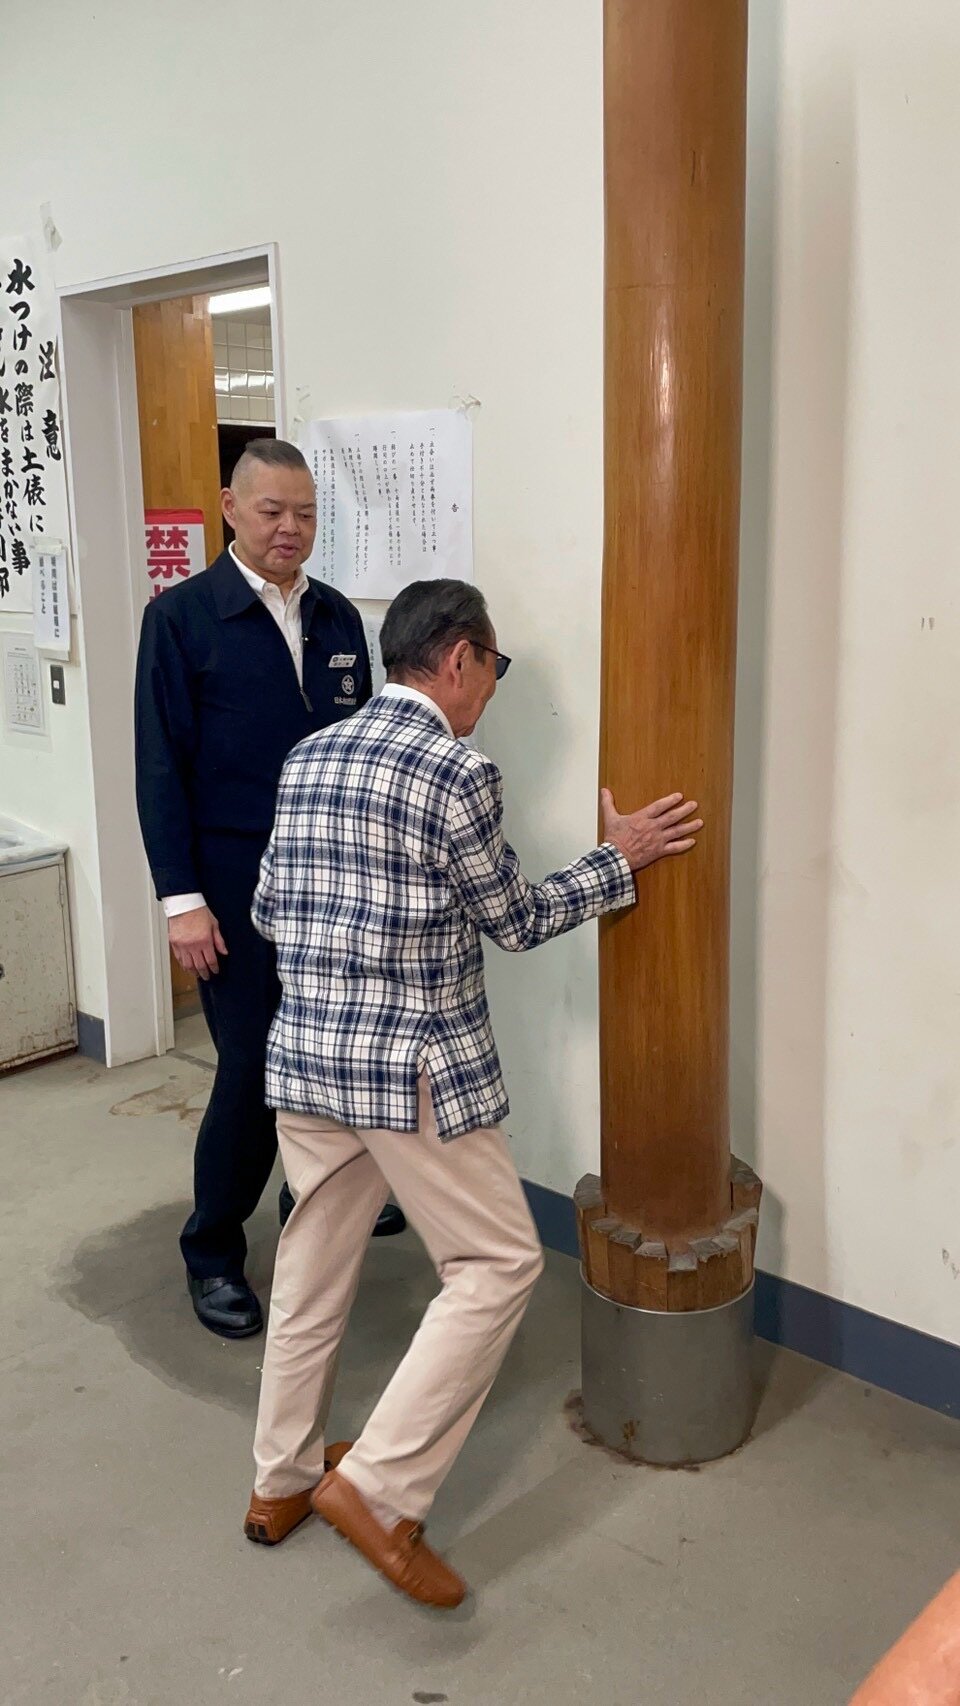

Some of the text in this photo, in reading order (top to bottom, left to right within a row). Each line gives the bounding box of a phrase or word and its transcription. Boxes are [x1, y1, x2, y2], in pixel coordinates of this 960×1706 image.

[6, 258, 46, 532] 水つけの際は土俵に
[145, 526, 190, 602] 禁
